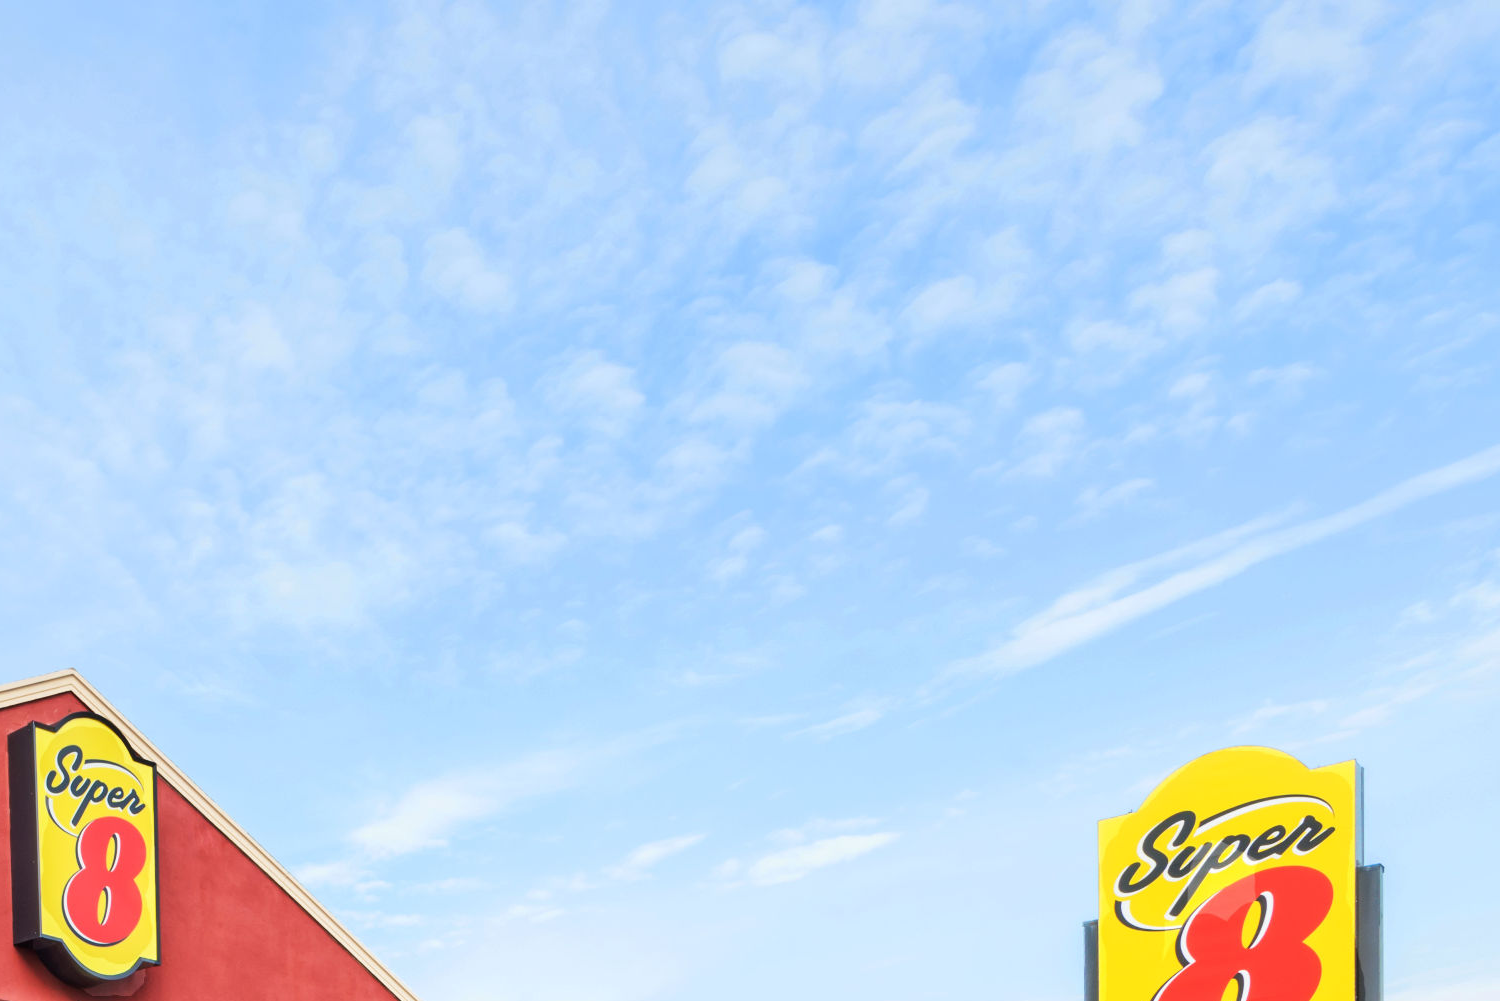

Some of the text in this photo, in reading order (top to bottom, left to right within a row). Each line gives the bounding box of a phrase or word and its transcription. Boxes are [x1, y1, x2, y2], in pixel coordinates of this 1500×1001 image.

[45, 744, 145, 828] Super
[62, 816, 147, 947] 8
[1115, 810, 1335, 920] Super
